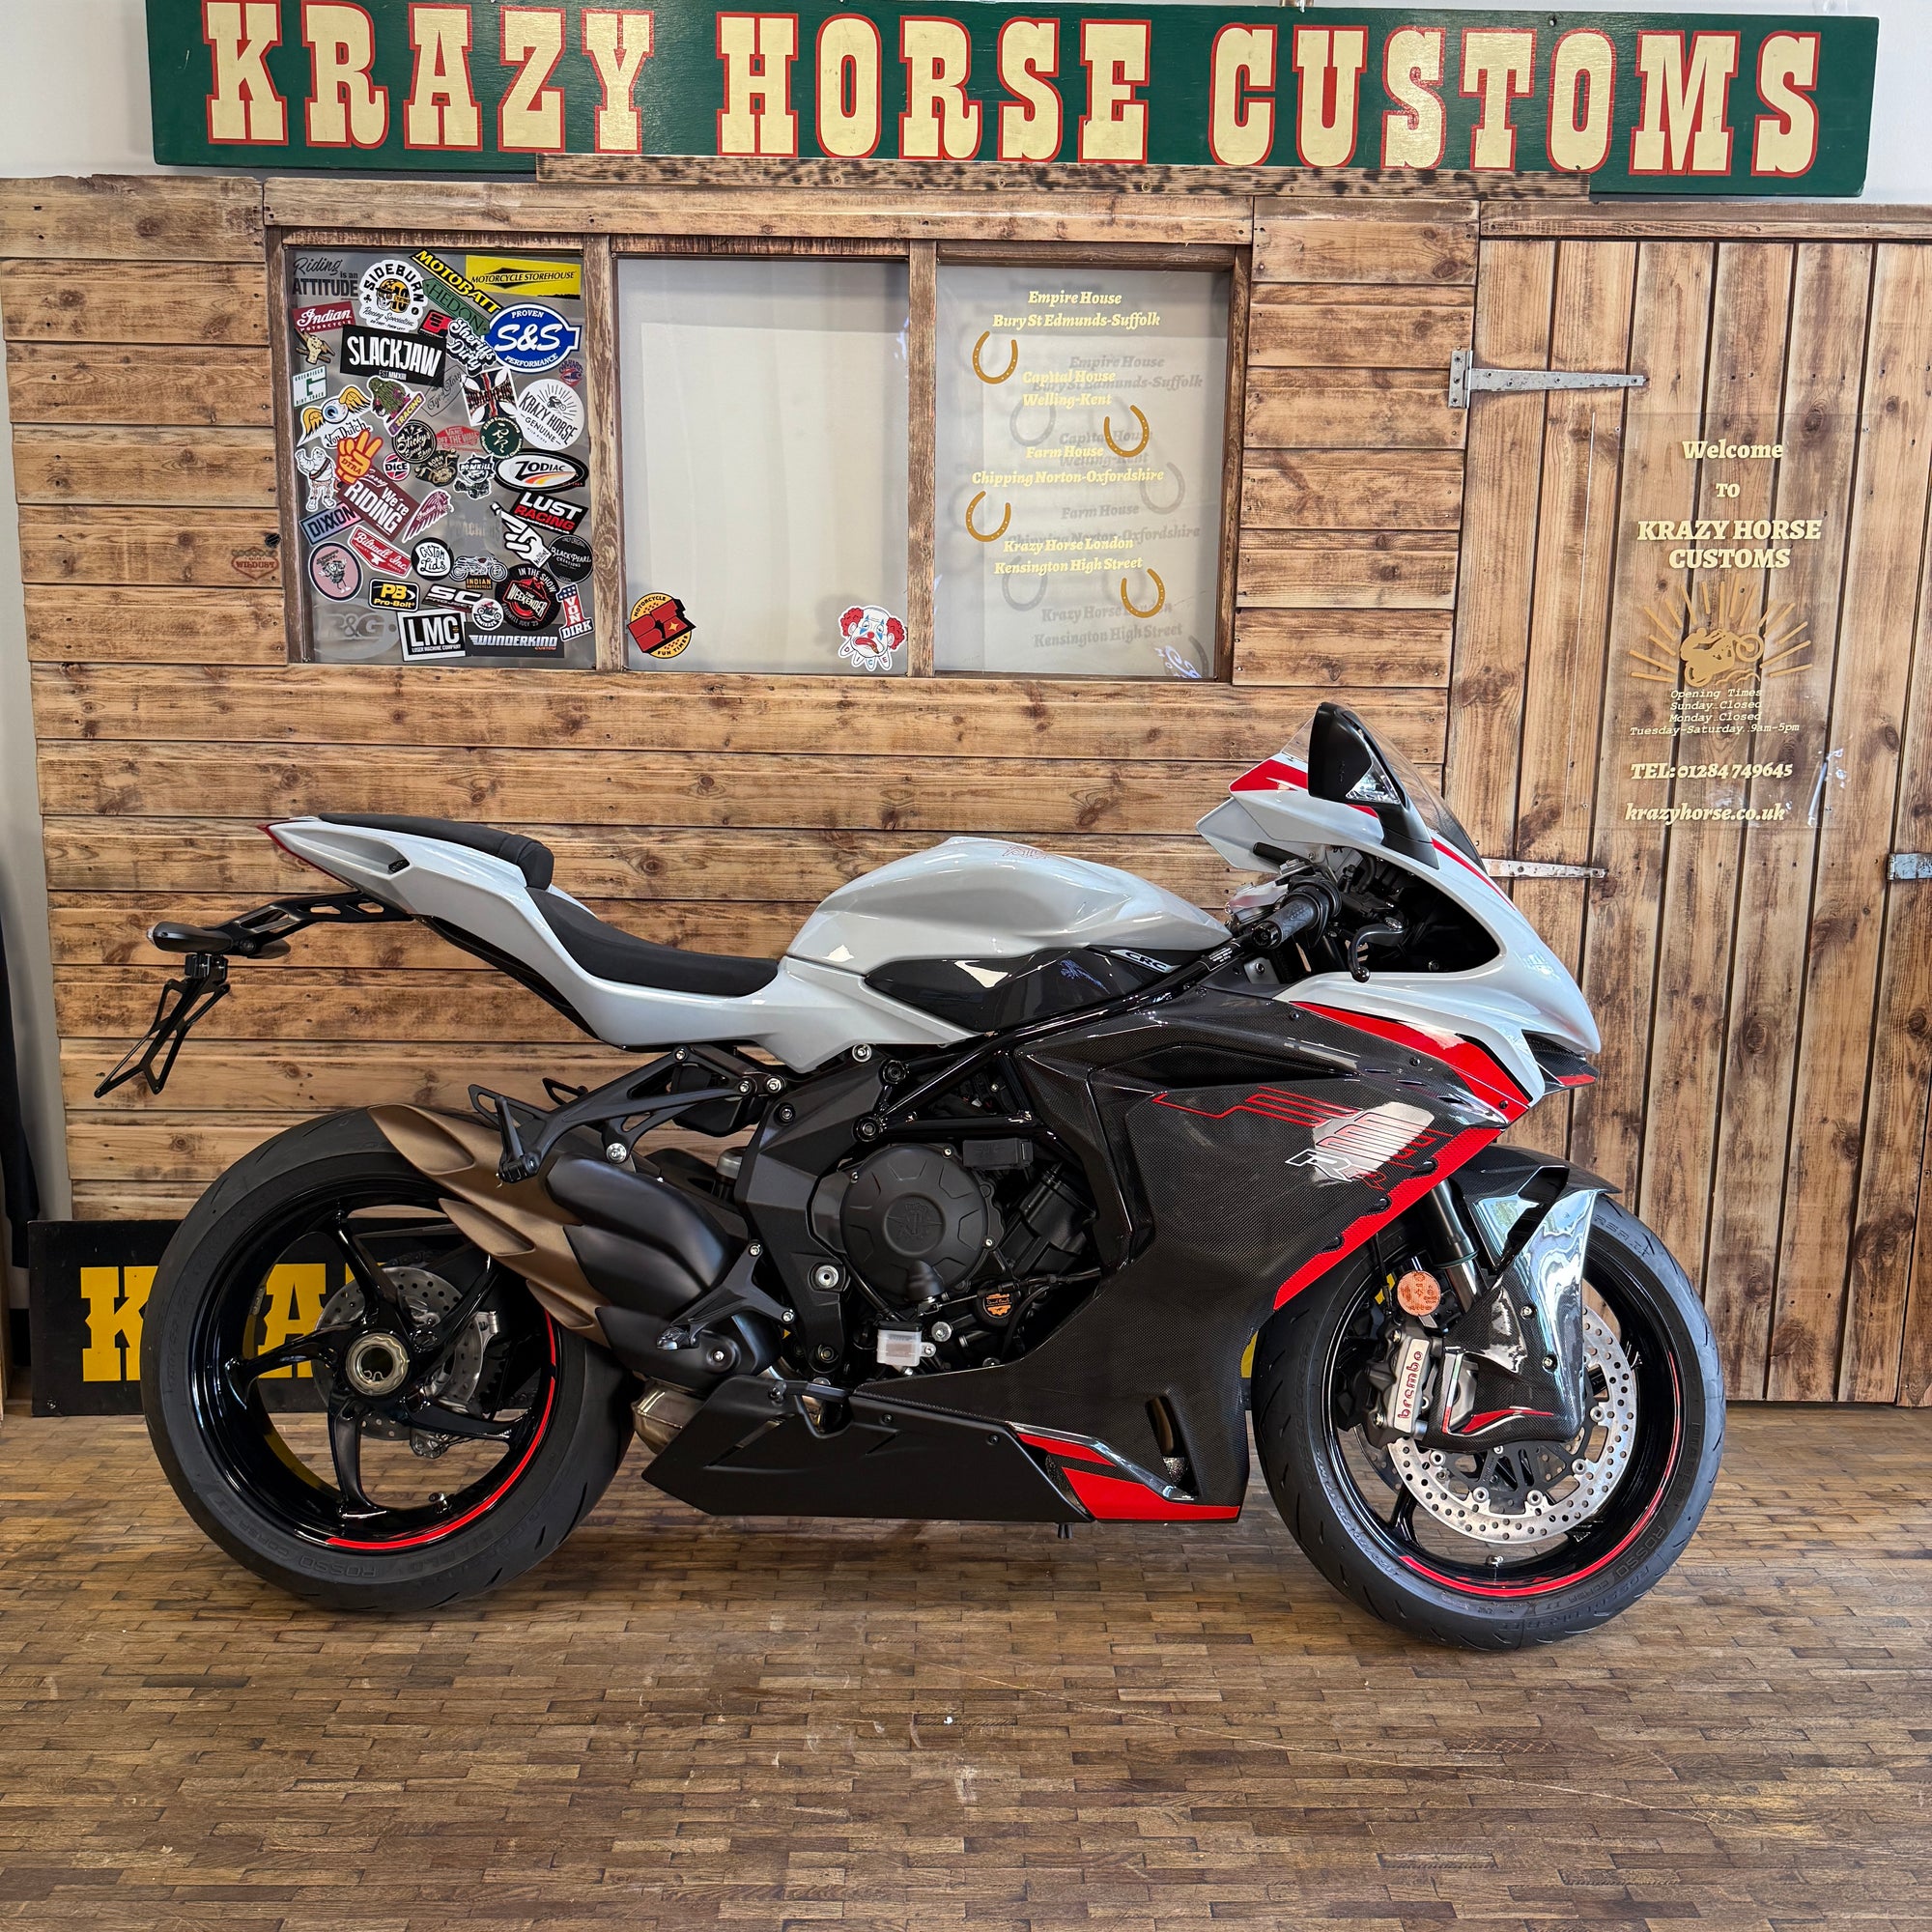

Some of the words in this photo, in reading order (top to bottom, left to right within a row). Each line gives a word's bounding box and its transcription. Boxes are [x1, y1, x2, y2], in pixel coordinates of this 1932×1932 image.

[202, 0, 654, 155] KRAZY
[716, 12, 1151, 163] HORSE
[1208, 23, 1820, 177] CUSTOMS
[293, 257, 343, 276] Riding
[363, 264, 424, 302] SIDEBURN
[416, 250, 500, 313] MOTOBATT
[471, 273, 523, 284] MOTORCYCLE
[525, 271, 577, 281] STOREHOUSE
[292, 278, 359, 298] ATTITUDE
[431, 285, 484, 331] HEDON
[1028, 290, 1078, 307] Empire
[1080, 291, 1122, 304] House
[297, 308, 352, 327] Indian
[511, 309, 544, 320] PROVEN
[993, 314, 1027, 330] Bury
[1028, 314, 1042, 327] St
[1043, 312, 1160, 329] Edmunds-Suffolk
[495, 324, 563, 352] S&S
[347, 336, 442, 378] SLACKJAW
[504, 353, 558, 368] PERFORMANCE
[1022, 369, 1072, 385] Capital
[1075, 370, 1116, 383] House
[1022, 393, 1111, 410] Welling-Kent
[519, 391, 551, 421] KRAZY
[547, 414, 578, 445] HORSE
[526, 417, 556, 442] GENUINE
[1026, 447, 1063, 459] Farm
[1065, 445, 1103, 458] House
[1682, 439, 1783, 460] Welcome
[341, 458, 362, 474] DTRA
[515, 461, 565, 481] ZODIAC
[972, 471, 1034, 487] Chipping
[1035, 468, 1164, 484] Norton-Oxfordshire
[1716, 483, 1740, 497] TO
[343, 480, 403, 533] RIDING
[382, 487, 410, 517] We're
[519, 492, 582, 520] LUST
[307, 504, 355, 538] DIXXON
[514, 505, 575, 530] RACING
[1637, 520, 1730, 541] KRAZY
[1732, 519, 1823, 540] HORSE
[354, 531, 393, 559] Biltwell
[420, 545, 445, 560] CUSTOM
[1004, 540, 1043, 554] Krazy
[1045, 538, 1083, 551] Horse
[1085, 536, 1133, 550] London
[420, 559, 447, 573] Lids
[571, 554, 591, 563] PEARL
[994, 561, 1068, 577] Kensington
[1070, 559, 1102, 574] High
[1103, 556, 1142, 569] Street
[1669, 548, 1791, 569] CUSTOMS
[527, 568, 541, 578] THE
[540, 573, 556, 592] SHOW
[381, 583, 408, 600] PB
[428, 585, 482, 603] SC
[507, 583, 548, 618] WEEKENDER
[564, 599, 581, 625] VON
[634, 596, 667, 617] MOTORCYCLE
[408, 615, 460, 647] LMC
[562, 620, 592, 640] DIRK
[469, 635, 558, 647] WUNDERKIND
[672, 635, 689, 653] TIMES
[1670, 690, 1720, 699] Opening
[1727, 688, 1763, 697] Times
[1720, 700, 1762, 710] Closed
[1719, 712, 1761, 722] Closed
[1750, 723, 1800, 733] 9am-5pm
[1625, 802, 1785, 825] krazyhorse.co.uk
[1125, 952, 1167, 971] CRC
[1398, 1350, 1423, 1418] brembo
